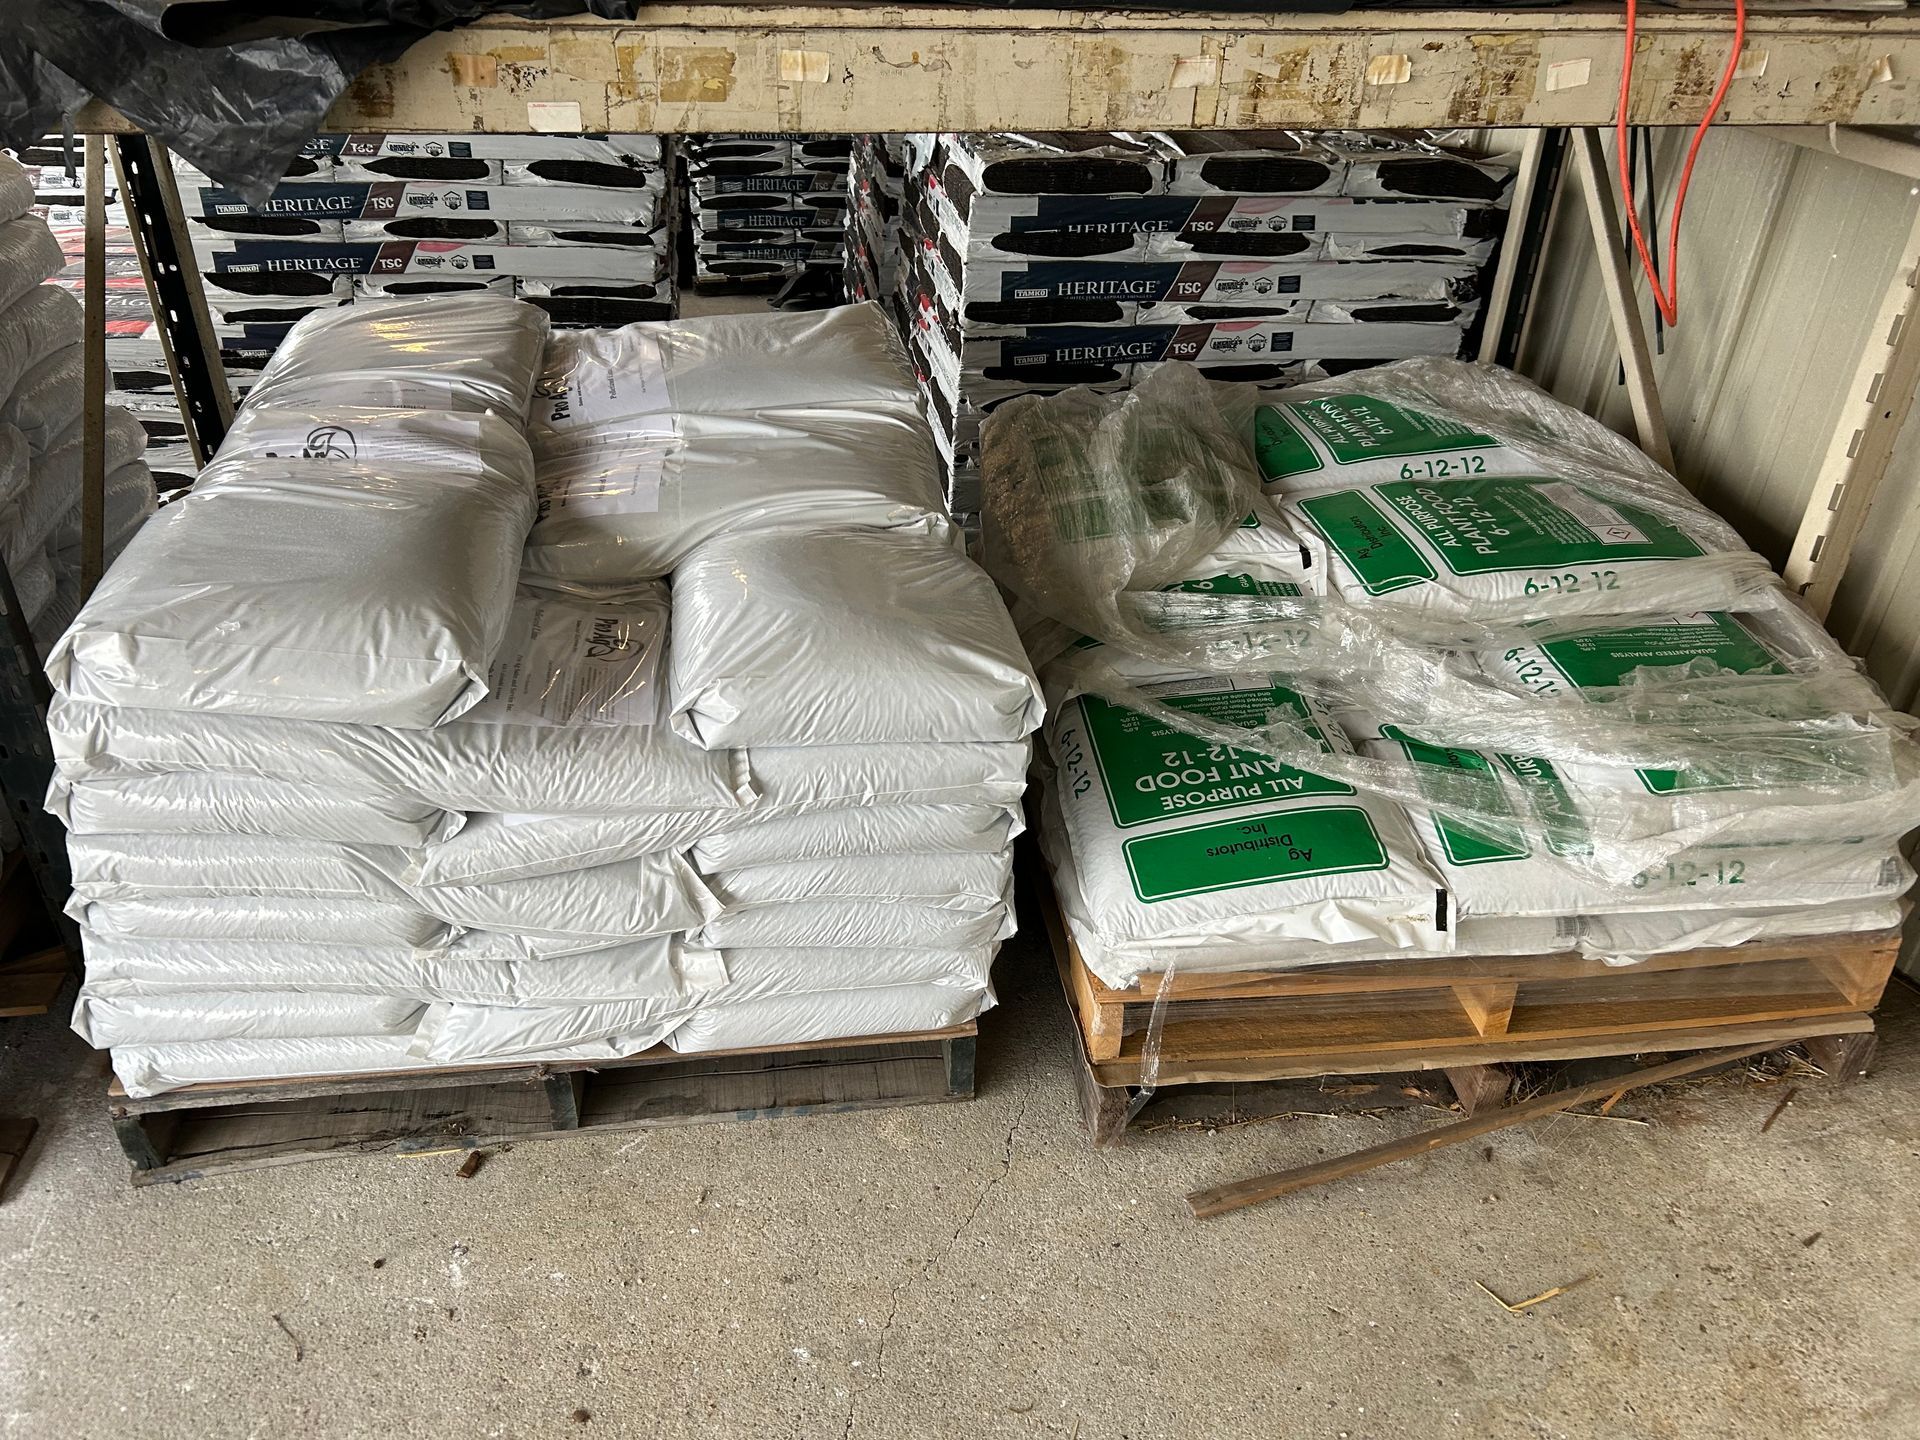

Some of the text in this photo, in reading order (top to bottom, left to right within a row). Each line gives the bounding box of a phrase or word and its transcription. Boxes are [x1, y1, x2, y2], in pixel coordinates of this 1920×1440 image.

[747, 179, 804, 190] HERITAGE
[217, 205, 247, 214] TAMKO
[371, 196, 395, 208] TSC
[749, 216, 807, 227] HERITAGE
[1190, 221, 1214, 232] TSC
[266, 257, 361, 272] HERITAGE
[379, 258, 403, 269] TSC
[1016, 289, 1047, 298] TAMKO
[1058, 280, 1157, 295] HERITAGE
[1177, 282, 1201, 294] TSC
[1055, 342, 1153, 361] HERITAGE
[1173, 342, 1197, 354] TSC
[1015, 355, 1045, 364] TAMKO
[1351, 405, 1394, 435] 6-12-12
[1400, 456, 1486, 480] 6-12-12
[1394, 494, 1462, 547] ALL PURPOSE
[1415, 487, 1500, 555] PLANT FOOD
[1452, 495, 1511, 536] 6-12-12
[1655, 648, 1717, 657] GUARANTEED
[1161, 743, 1241, 767] 12-12
[1061, 728, 1092, 801] 6-12-12
[1510, 754, 1549, 786] PURP
[1135, 759, 1282, 792] ANT FOOD
[1160, 775, 1304, 811] ALL PURPOSE
[1236, 823, 1268, 835] Inc.
[1206, 833, 1294, 858] Distributors
[1288, 847, 1313, 862] Ag
